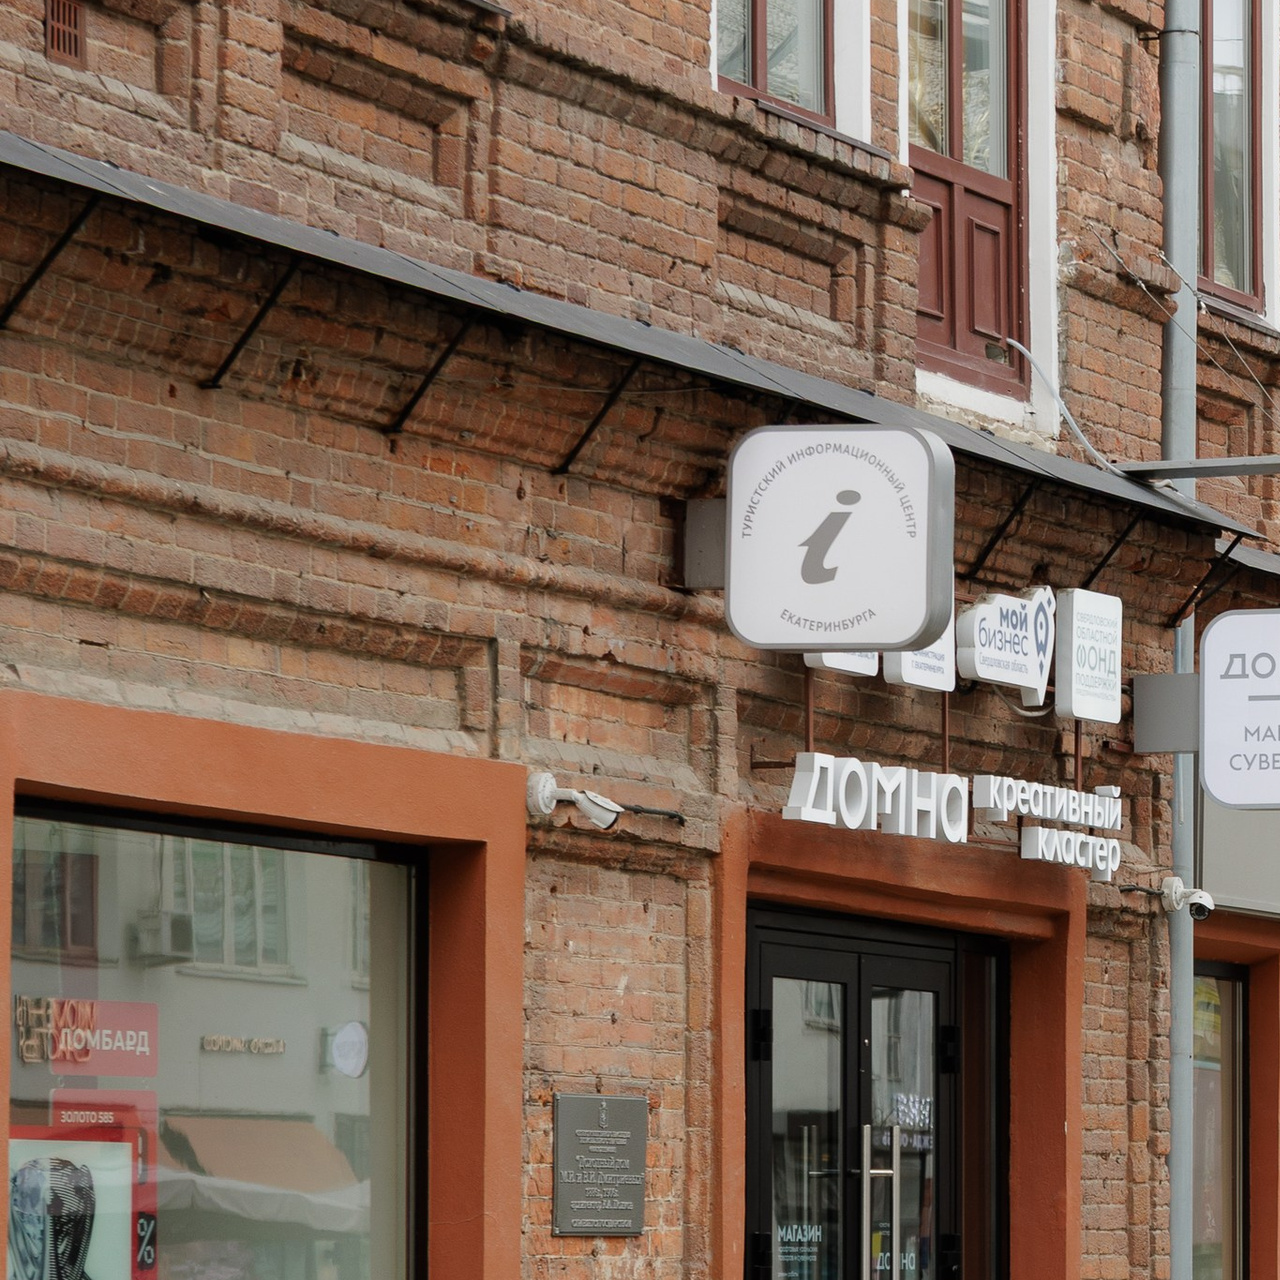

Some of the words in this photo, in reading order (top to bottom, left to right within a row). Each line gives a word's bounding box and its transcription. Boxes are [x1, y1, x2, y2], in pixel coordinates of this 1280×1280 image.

[742, 460, 786, 539] ТУРИСТСКИЙ
[787, 442, 905, 494] ИНФОРМАЦИОННЫЙ
[899, 495, 917, 539] ЦЕНТР
[779, 608, 877, 632] ЕКАТЕРИНБУРГА
[1000, 603, 1028, 632] мой
[978, 617, 1029, 656] бизнес
[1076, 626, 1118, 645] ОБЛАСТНОЙ
[1076, 644, 1117, 678] ФОНД
[1075, 673, 1117, 691] ПОДДЕРЖКИ
[973, 775, 1122, 830] креативный
[1021, 826, 1120, 882] кластер
[61, 1111, 97, 1124] ЗОЛОТО
[98, 1112, 114, 1124] 585
[778, 1225, 822, 1242] МАГАЗИН
